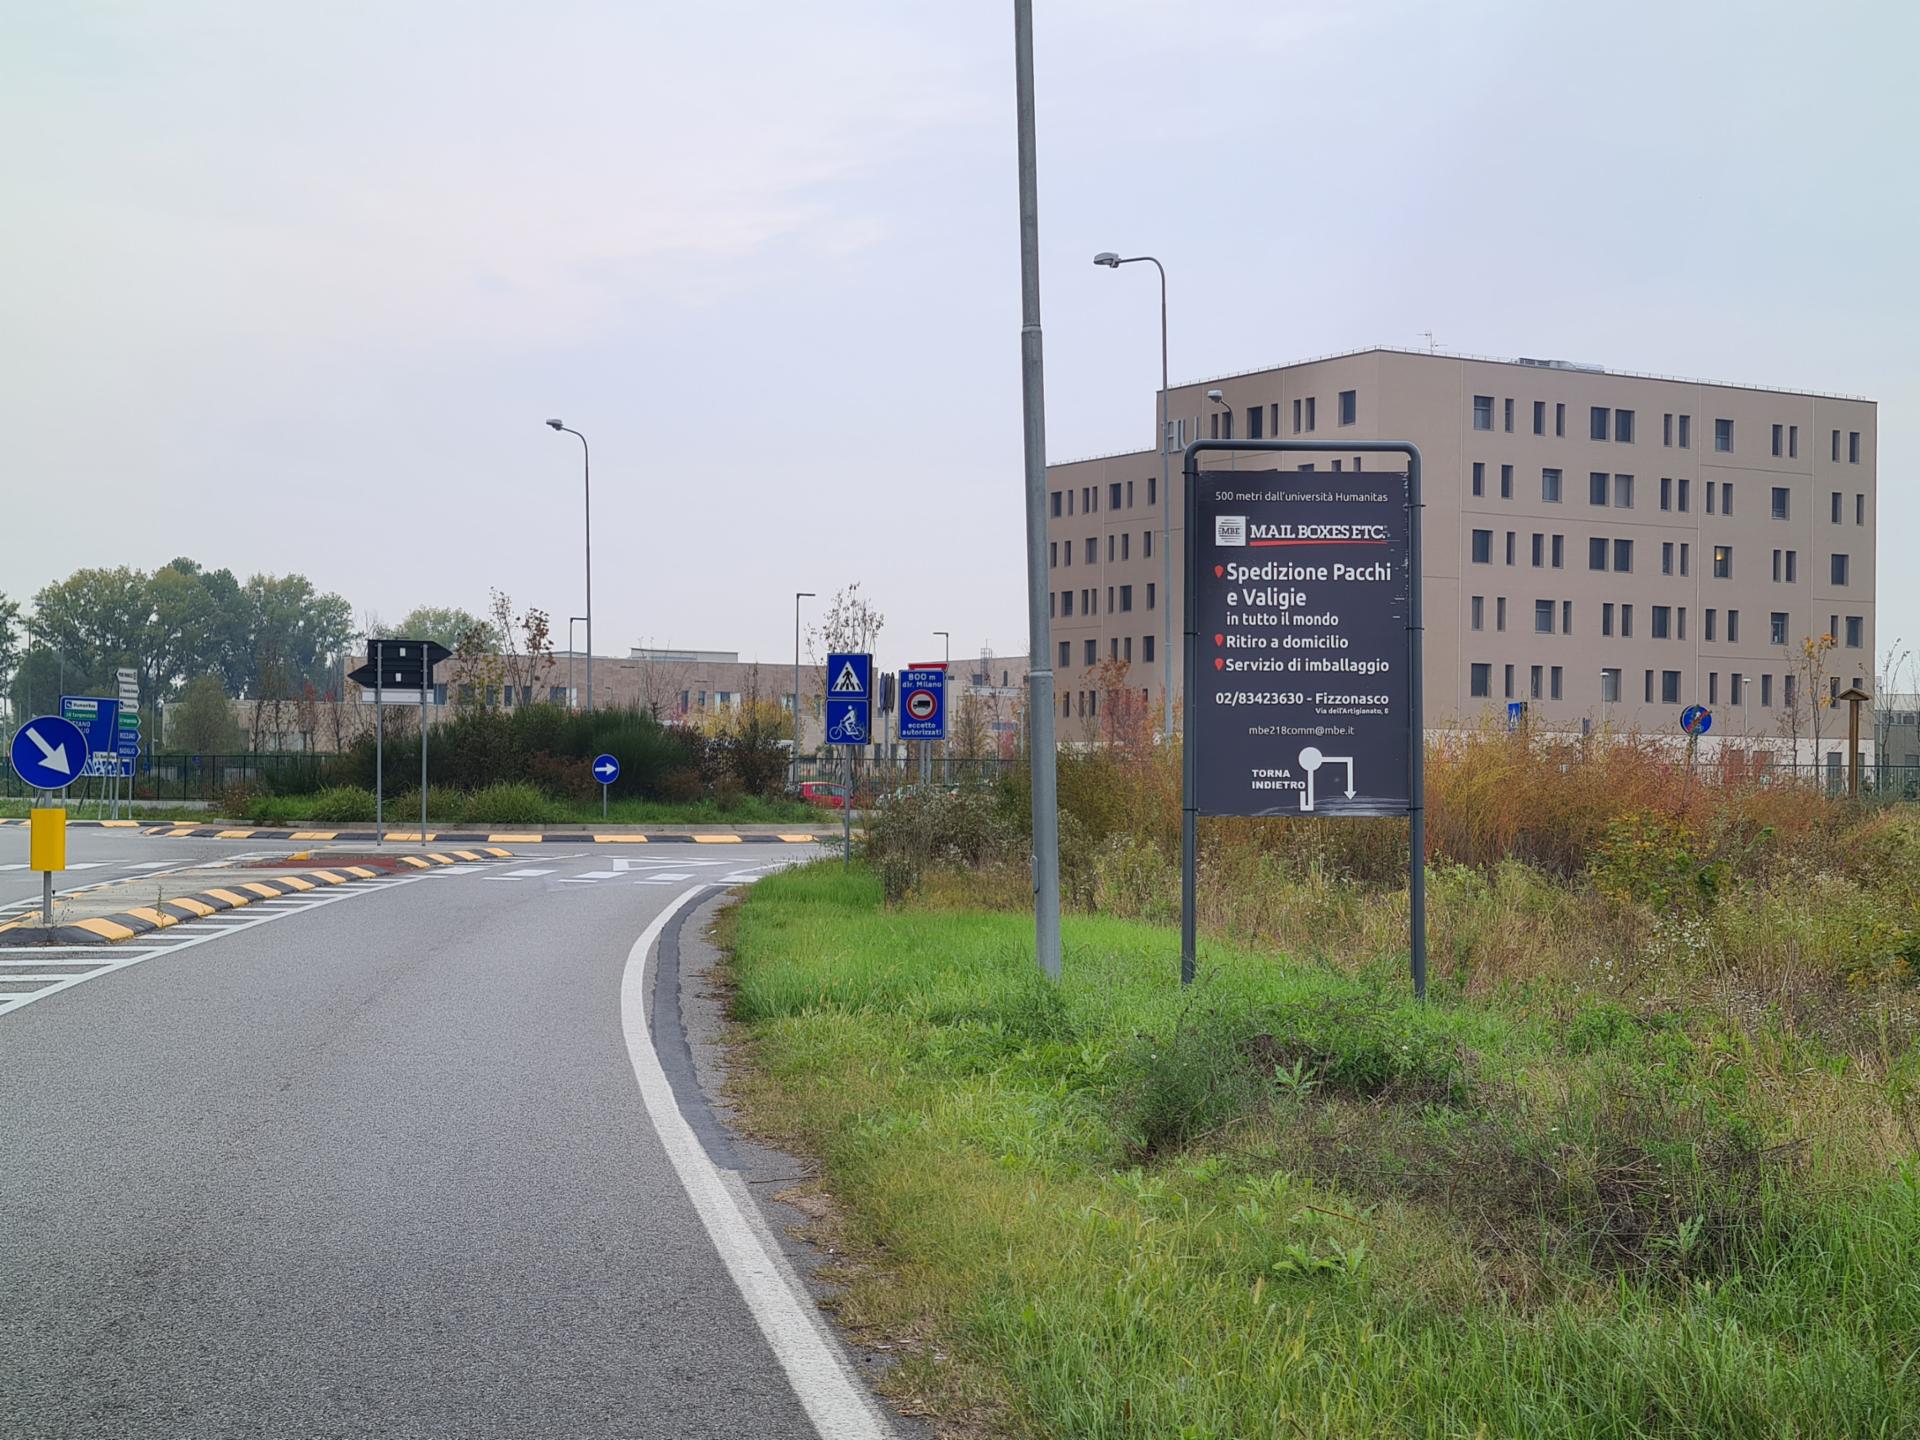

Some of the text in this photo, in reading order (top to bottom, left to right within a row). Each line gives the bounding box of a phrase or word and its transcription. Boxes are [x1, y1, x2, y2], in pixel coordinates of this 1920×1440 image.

[1215, 491, 1388, 502] 500 metri dall'università Humanitas
[1250, 524, 1296, 539] MAIL
[1297, 524, 1350, 539] BOXES
[1226, 562, 1391, 585] Spedizione Pacchi
[1227, 587, 1307, 610] e Valigie
[1226, 611, 1339, 626] in tutto il mondo
[1226, 634, 1349, 649] Ritiro a domicilio
[1225, 658, 1390, 675] Servizio di imballaggio
[1215, 691, 1304, 707] 02/83423630
[1315, 692, 1389, 705] Fizzonasco
[1249, 726, 1355, 736] mbe218comm@mbe.it
[1252, 769, 1291, 778] TORNA
[1252, 781, 1306, 790] INDIETRO
